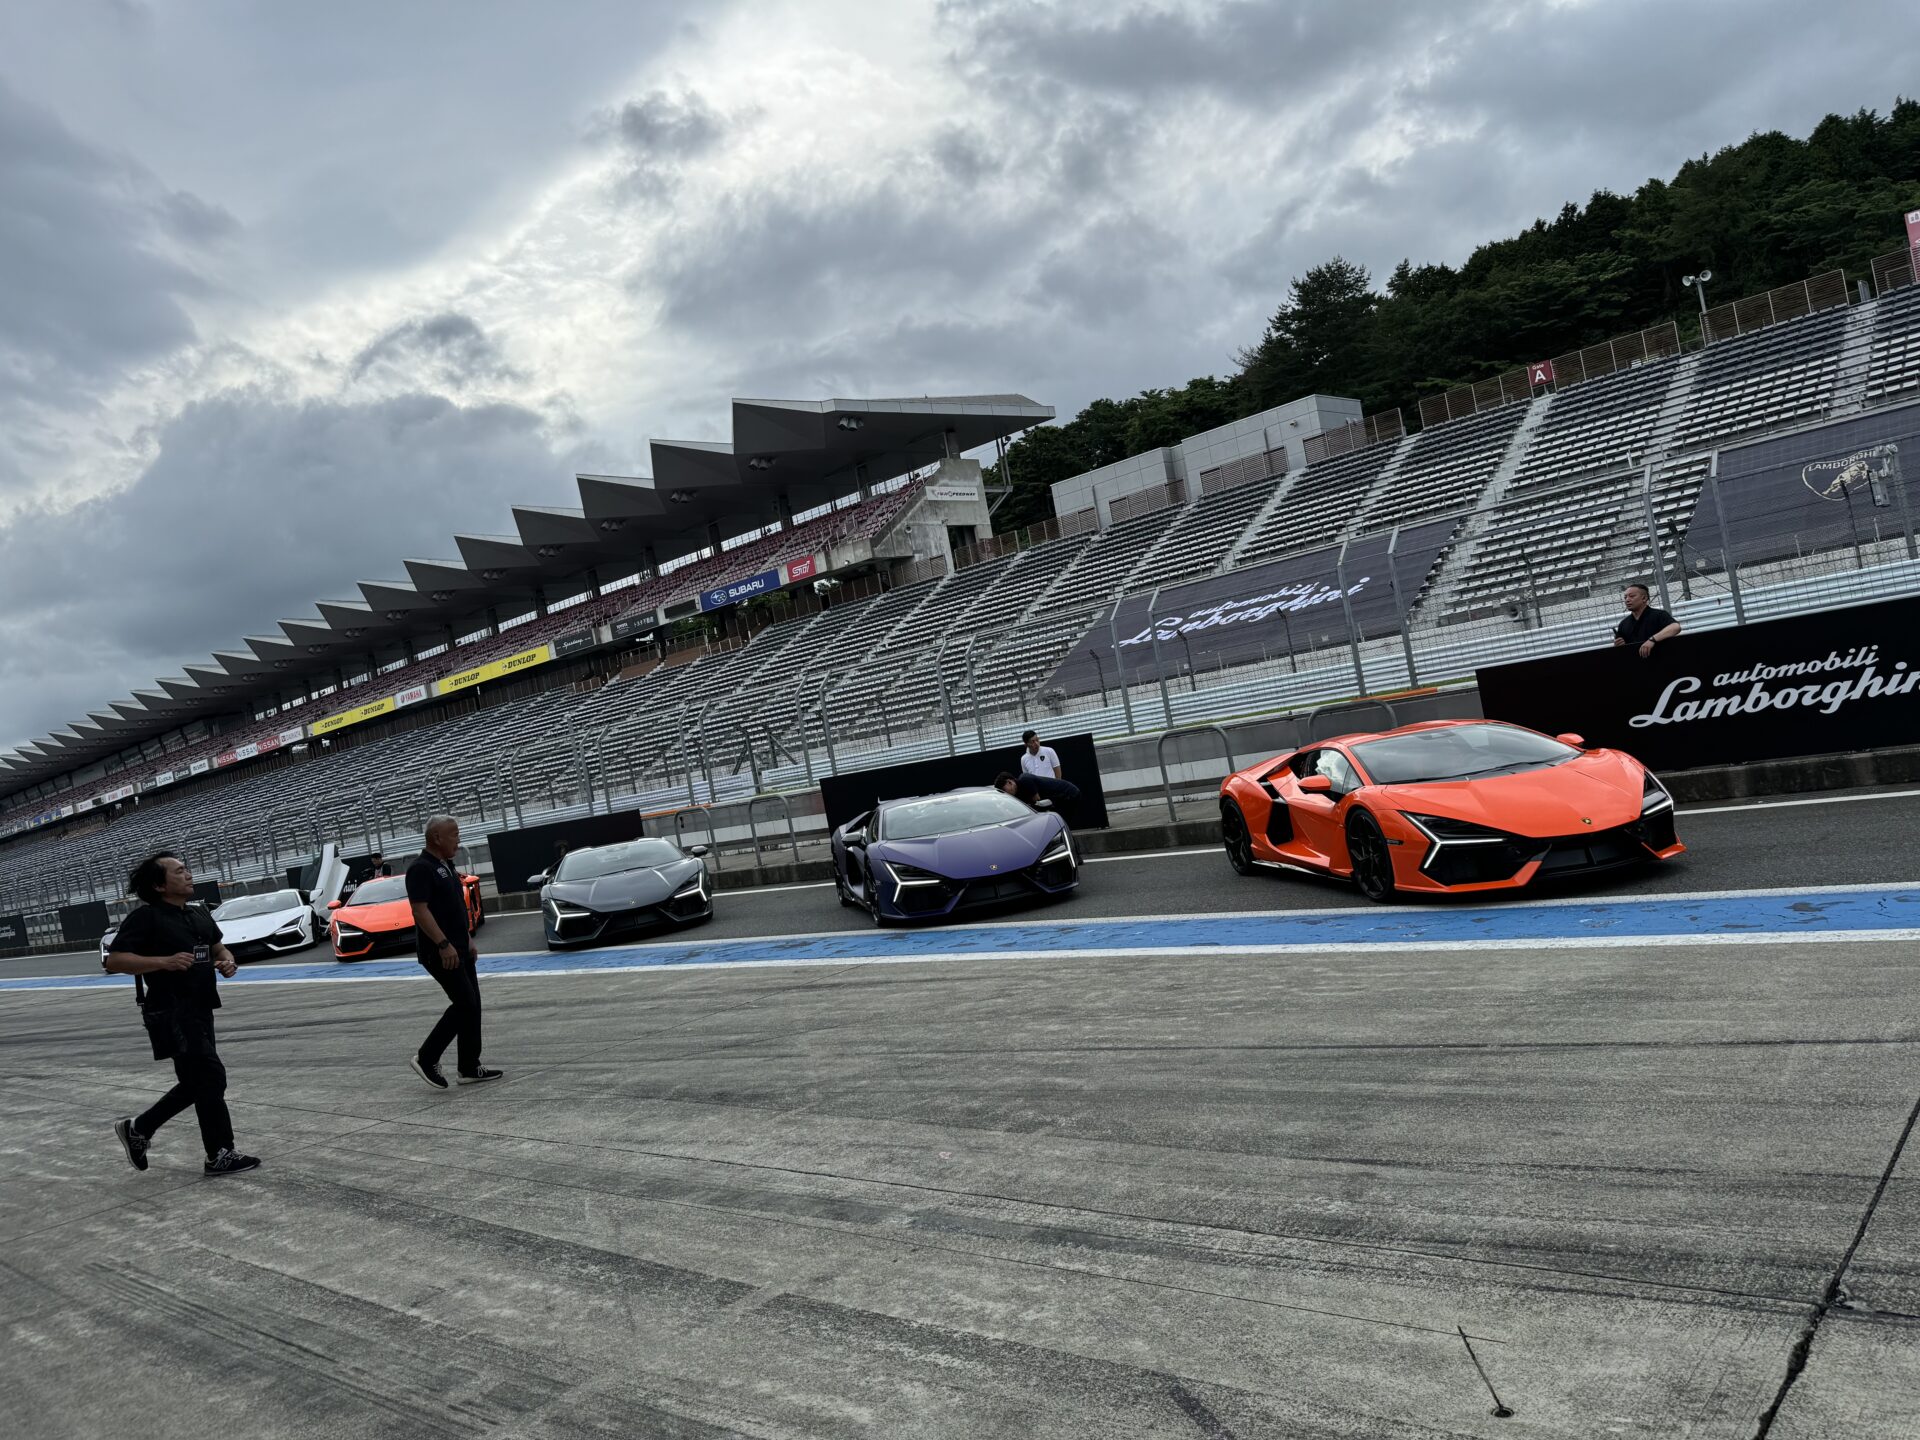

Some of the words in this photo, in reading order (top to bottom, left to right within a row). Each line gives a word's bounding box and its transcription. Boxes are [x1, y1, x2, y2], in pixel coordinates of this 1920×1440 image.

[1534, 369, 1546, 383] A
[728, 579, 765, 598] SUBARU
[507, 653, 536, 669] DUNLOP
[1712, 644, 1880, 687] automobili
[453, 672, 480, 686] DUNLOP
[405, 689, 422, 702] YAMAHA
[363, 703, 385, 716] DUNLOP
[324, 717, 344, 729] DUNLOP
[237, 745, 257, 757] NISSAN
[258, 739, 280, 751] NISSAN
[217, 752, 237, 765] NISSAN
